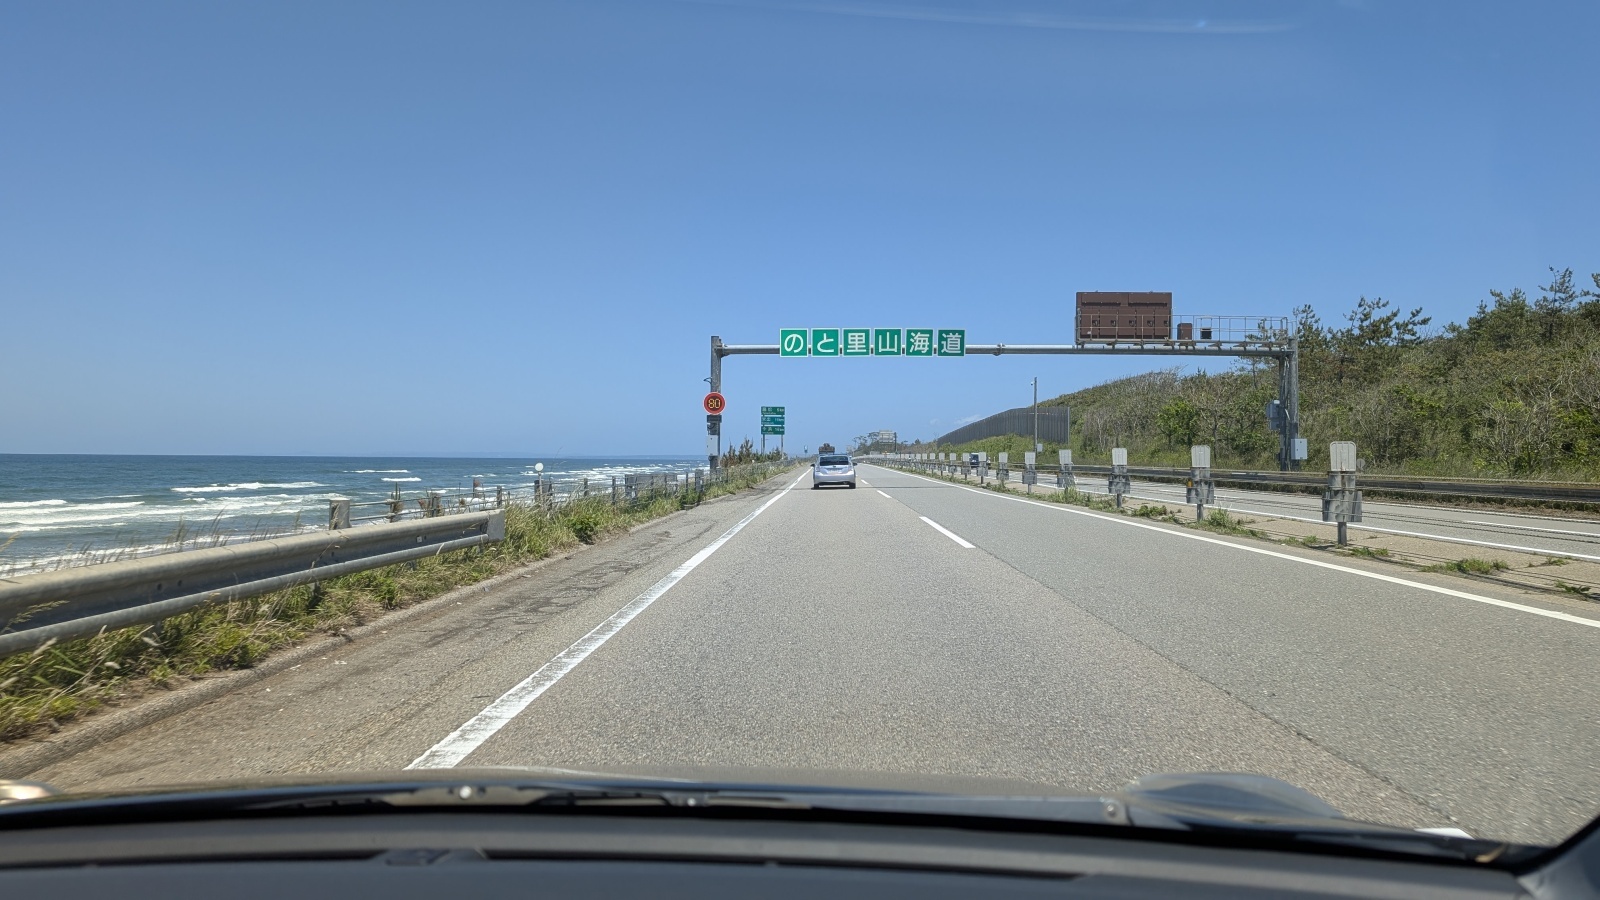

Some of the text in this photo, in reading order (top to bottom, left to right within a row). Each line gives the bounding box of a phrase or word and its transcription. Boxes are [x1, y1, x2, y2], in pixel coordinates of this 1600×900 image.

[784, 332, 962, 354] のと里山海道
[708, 398, 721, 409] 80
